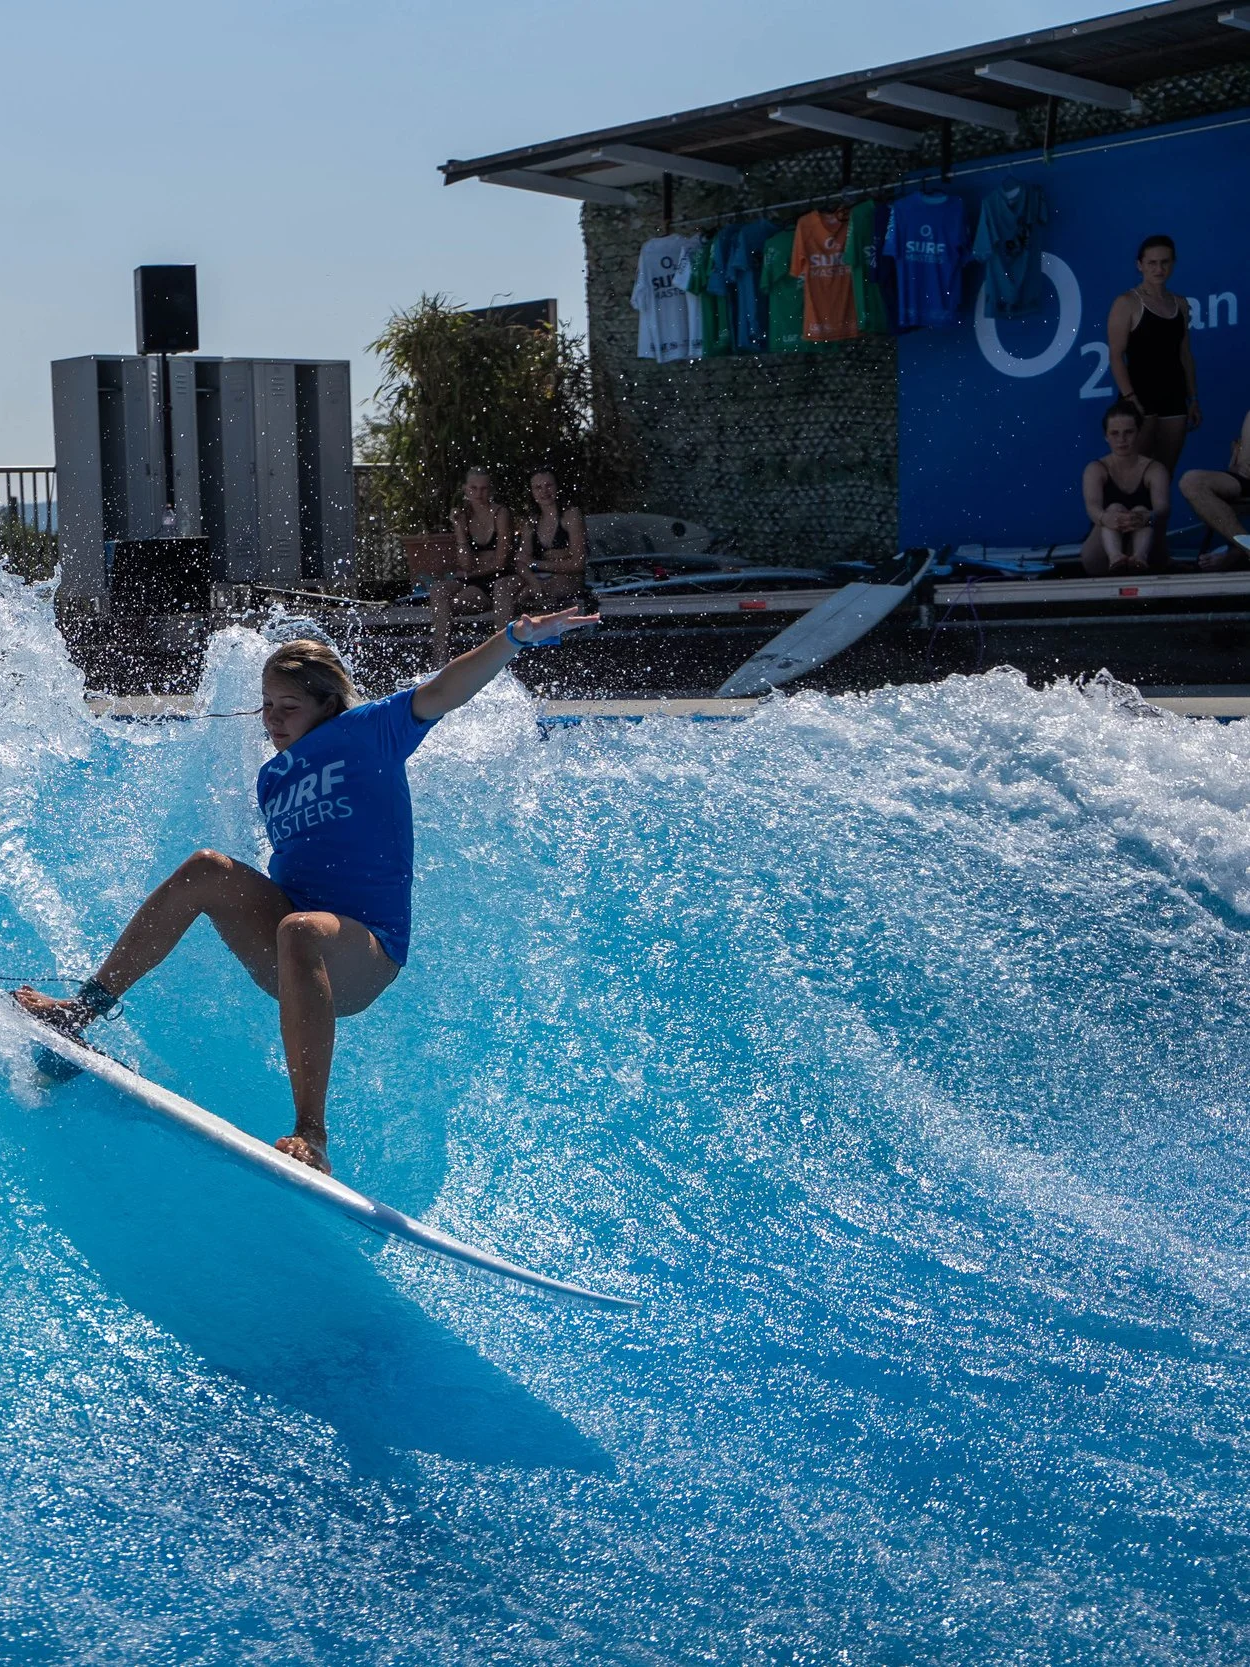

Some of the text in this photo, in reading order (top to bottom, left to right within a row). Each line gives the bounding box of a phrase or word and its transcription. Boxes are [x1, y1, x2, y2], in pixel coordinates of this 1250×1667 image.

[905, 240, 946, 256] SURF
[1187, 290, 1238, 331] an
[272, 796, 353, 847] ASTERS
